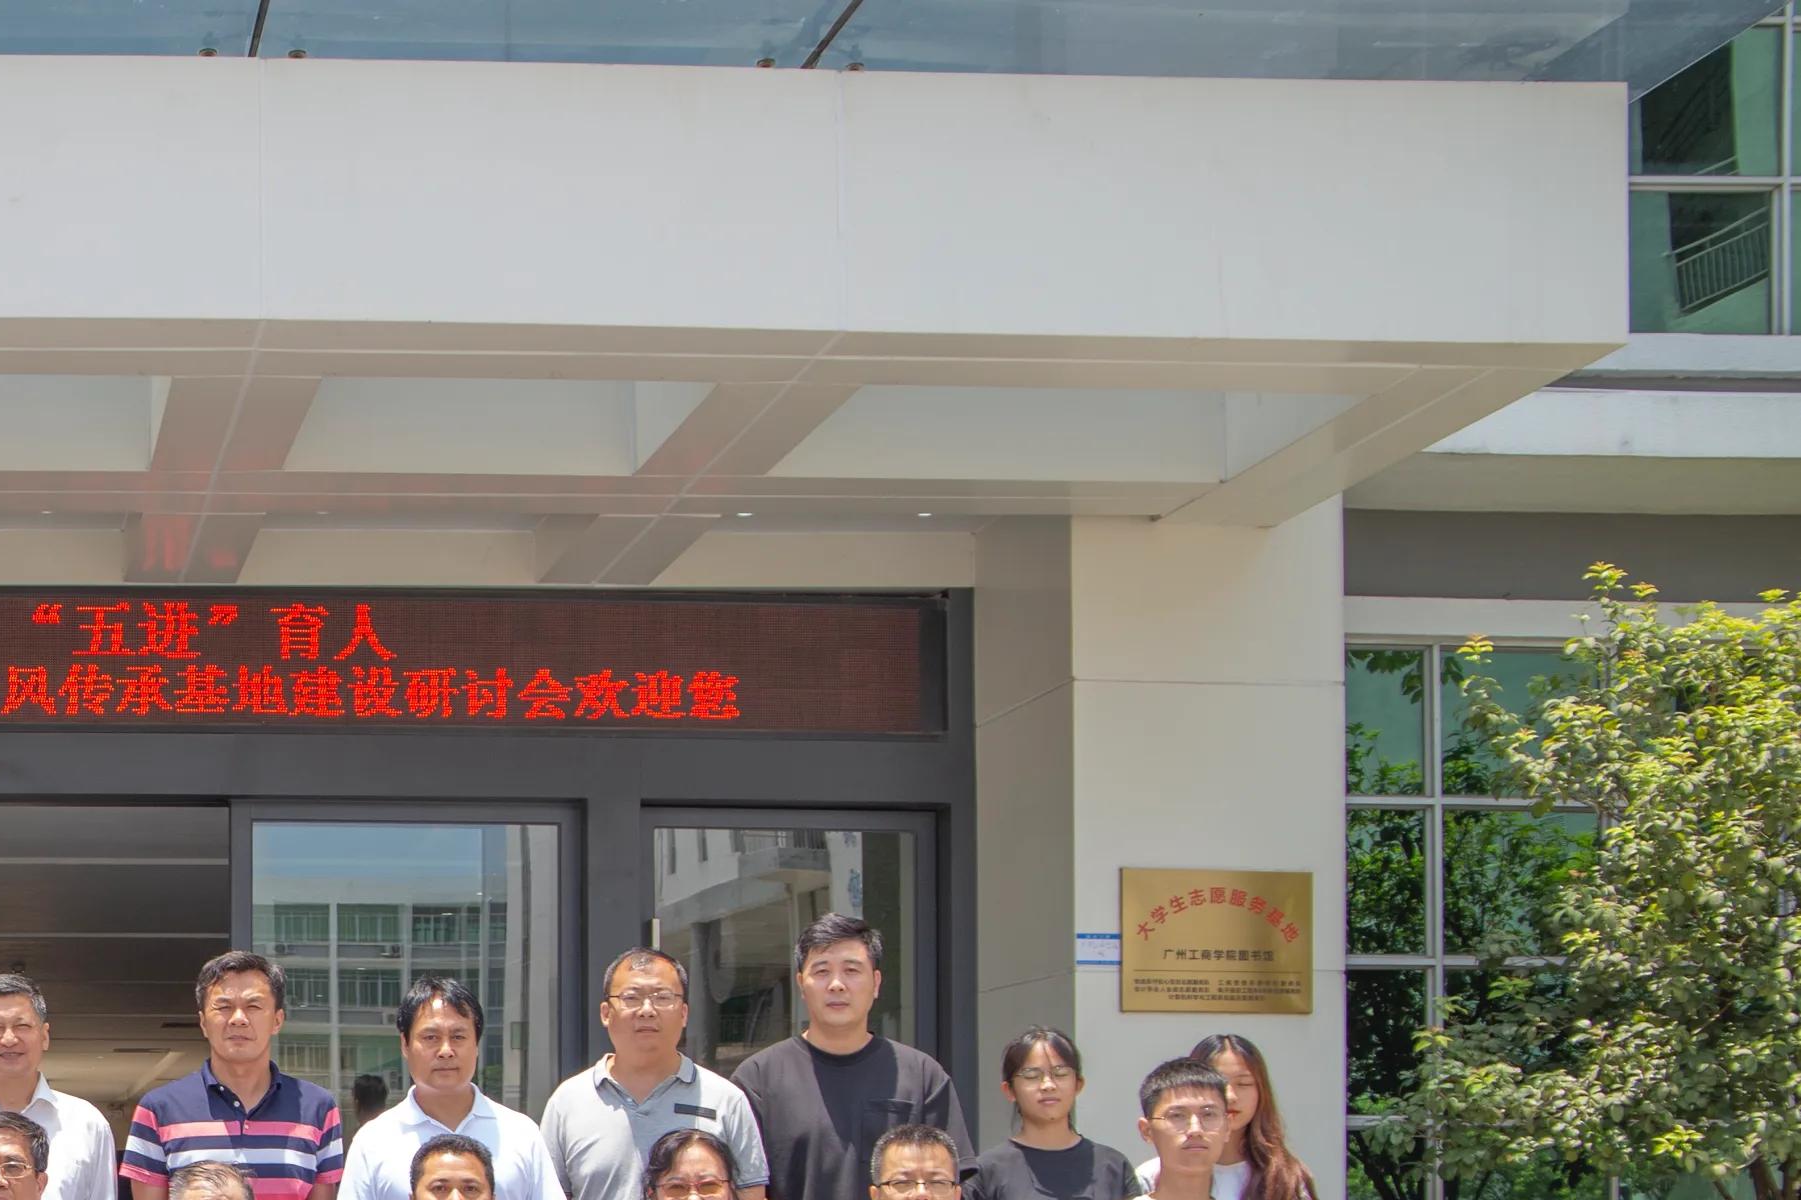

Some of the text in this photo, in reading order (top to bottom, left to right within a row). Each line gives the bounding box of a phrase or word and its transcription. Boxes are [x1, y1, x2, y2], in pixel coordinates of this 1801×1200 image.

[1136, 886, 1300, 943] 大学生志愿服务基地
[1163, 949, 1275, 962] 广州工商学院图书馆
